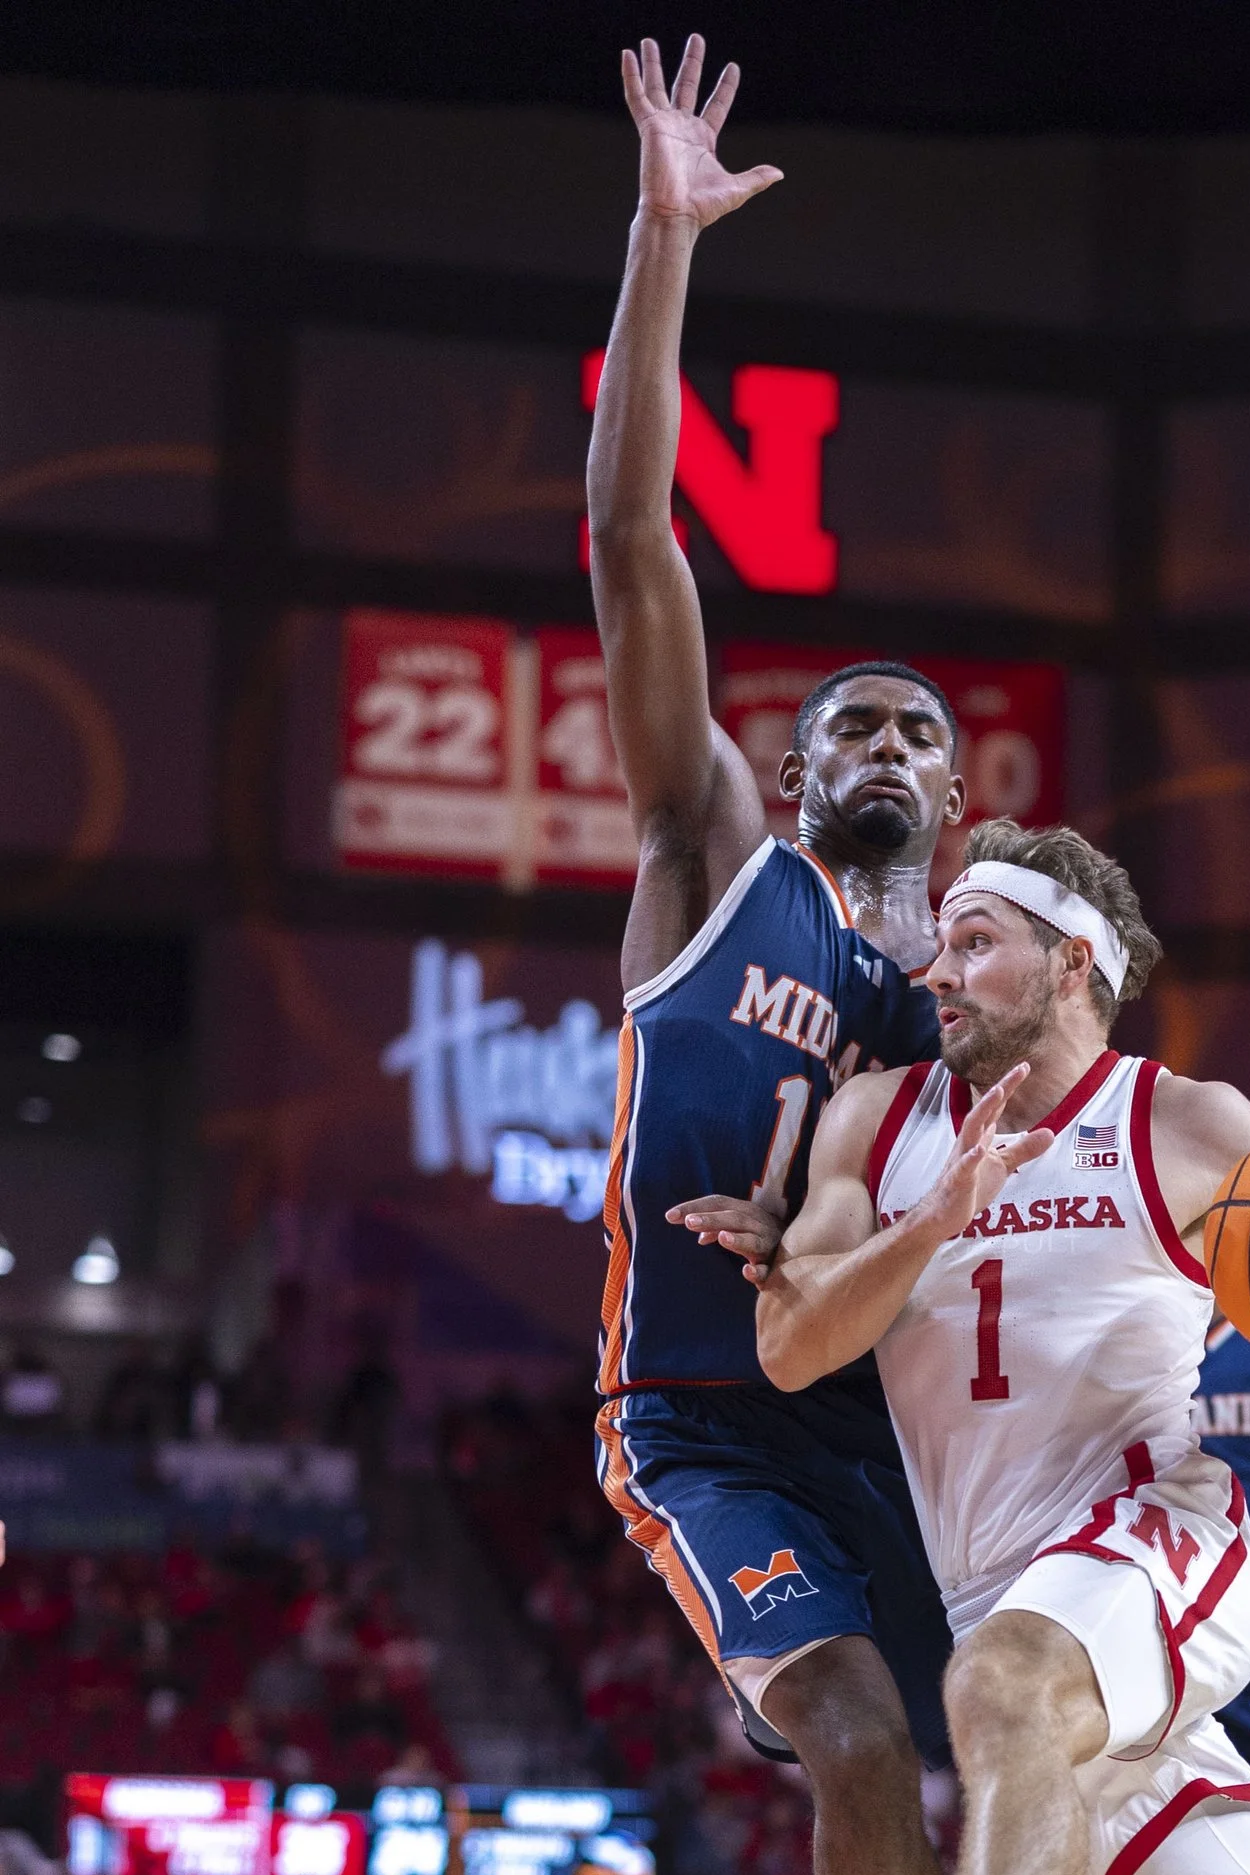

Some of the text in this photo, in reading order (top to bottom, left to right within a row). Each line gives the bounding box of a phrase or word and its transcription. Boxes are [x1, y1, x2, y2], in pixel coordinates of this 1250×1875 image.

[353, 683, 498, 778] 22
[543, 700, 628, 788] 4
[971, 1259, 1009, 1401] 1
[727, 1548, 820, 1621] M
[1126, 1501, 1202, 1590] N
